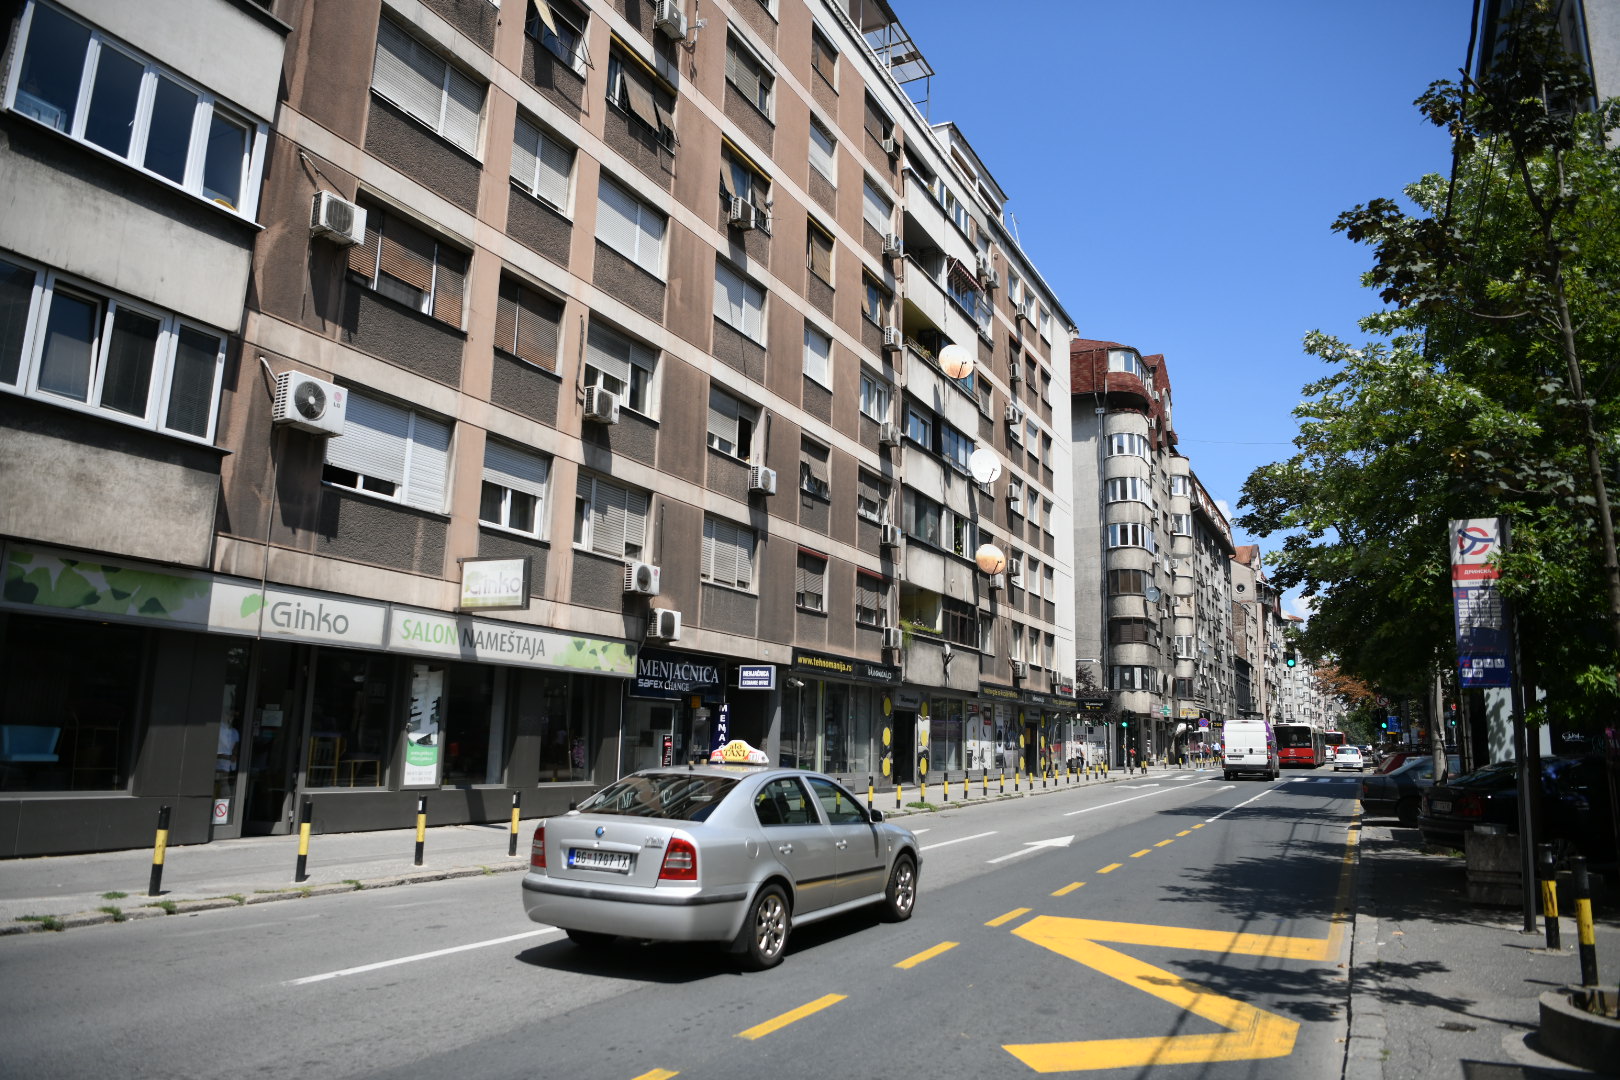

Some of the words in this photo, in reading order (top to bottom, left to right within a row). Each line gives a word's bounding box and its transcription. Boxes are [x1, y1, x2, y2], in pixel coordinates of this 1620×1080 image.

[270, 601, 349, 635] Ginko
[401, 619, 458, 645] SALON
[462, 628, 546, 660] NAMEŠTAJA
[639, 659, 719, 684] MENJAČNICA
[797, 656, 852, 673] www.tehnomanija.rs
[723, 749, 747, 757] TAXI
[575, 851, 587, 863] BG
